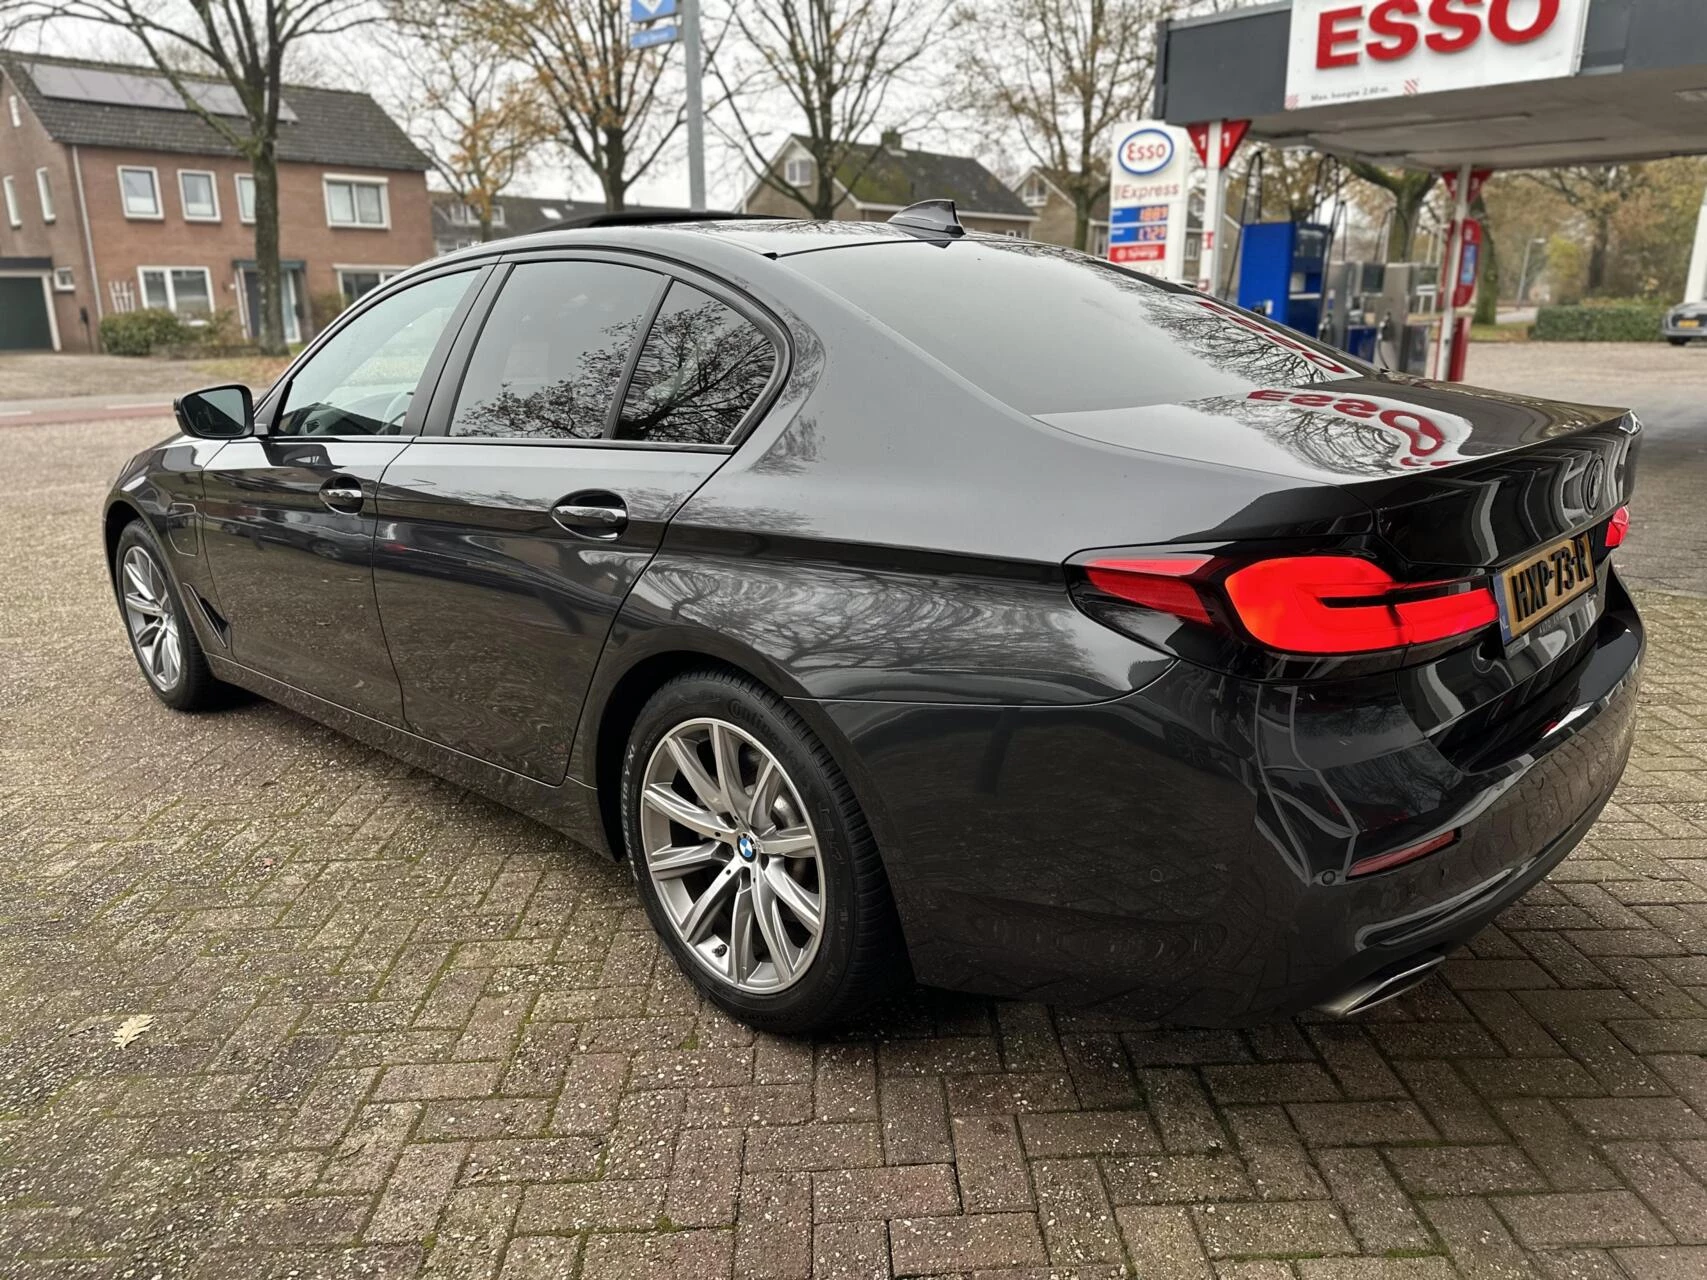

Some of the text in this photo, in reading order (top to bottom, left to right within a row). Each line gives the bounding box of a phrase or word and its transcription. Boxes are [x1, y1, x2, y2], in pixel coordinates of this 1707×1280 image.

[1316, 0, 1560, 70] ESSO
[1126, 142, 1167, 162] Esso
[1121, 183, 1180, 201] Express
[1511, 536, 1590, 623] HXP-73-R
